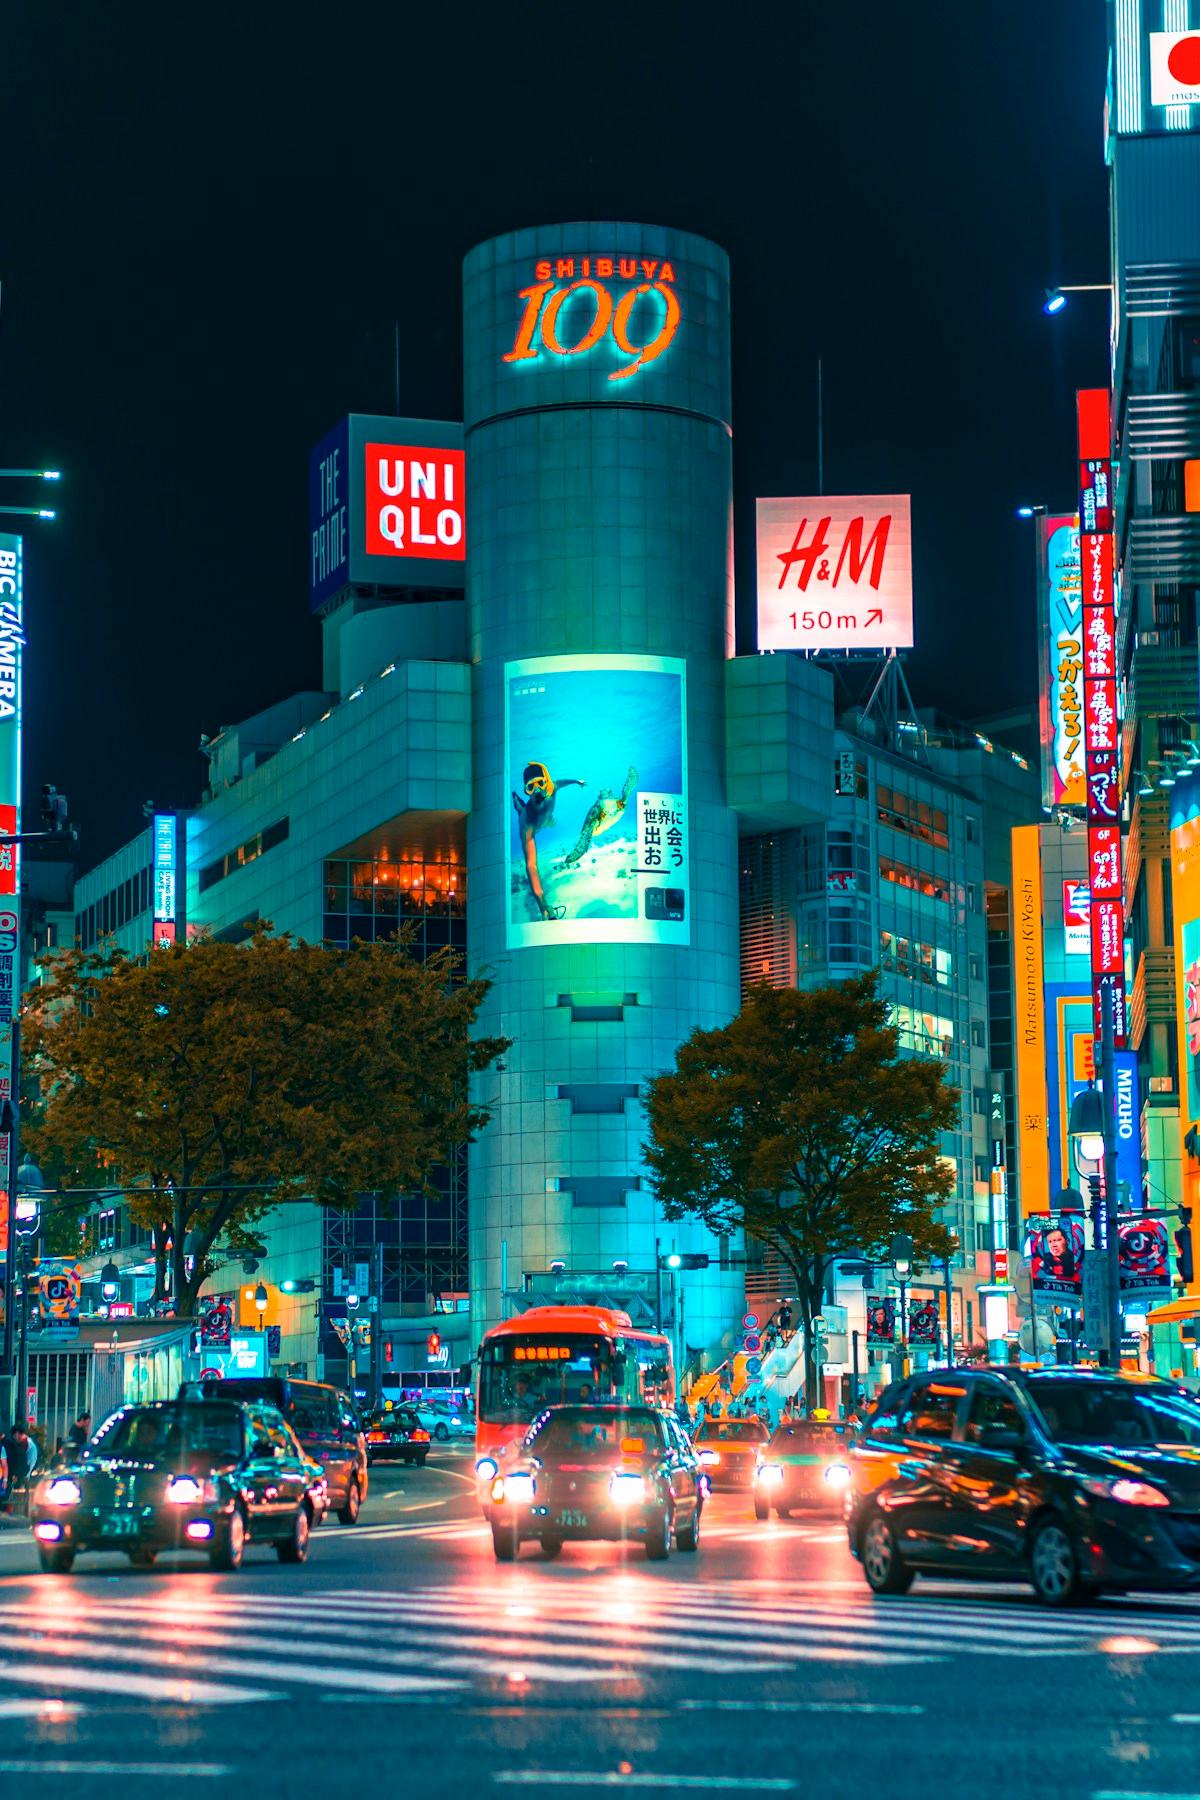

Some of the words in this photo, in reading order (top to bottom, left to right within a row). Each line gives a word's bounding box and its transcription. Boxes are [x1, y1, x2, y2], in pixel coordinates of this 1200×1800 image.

[535, 257, 675, 282] SHIBUYA
[502, 279, 681, 381] 109
[319, 448, 340, 518] THE
[378, 458, 454, 502] UNI
[312, 505, 346, 588] PRIME
[379, 504, 462, 549] QLO
[776, 514, 892, 592] H&M
[789, 611, 857, 630] 150m
[1092, 607, 1105, 618] 7F
[1094, 681, 1107, 691] 7F
[1095, 754, 1109, 764] 6F
[643, 809, 683, 826] 世界に
[1098, 829, 1111, 840] 6F
[1021, 878, 1034, 941] KiYoshi
[1099, 904, 1113, 915] 6F
[1025, 947, 1037, 1046] Matsumoto
[1117, 1069, 1132, 1139] MIZUHO
